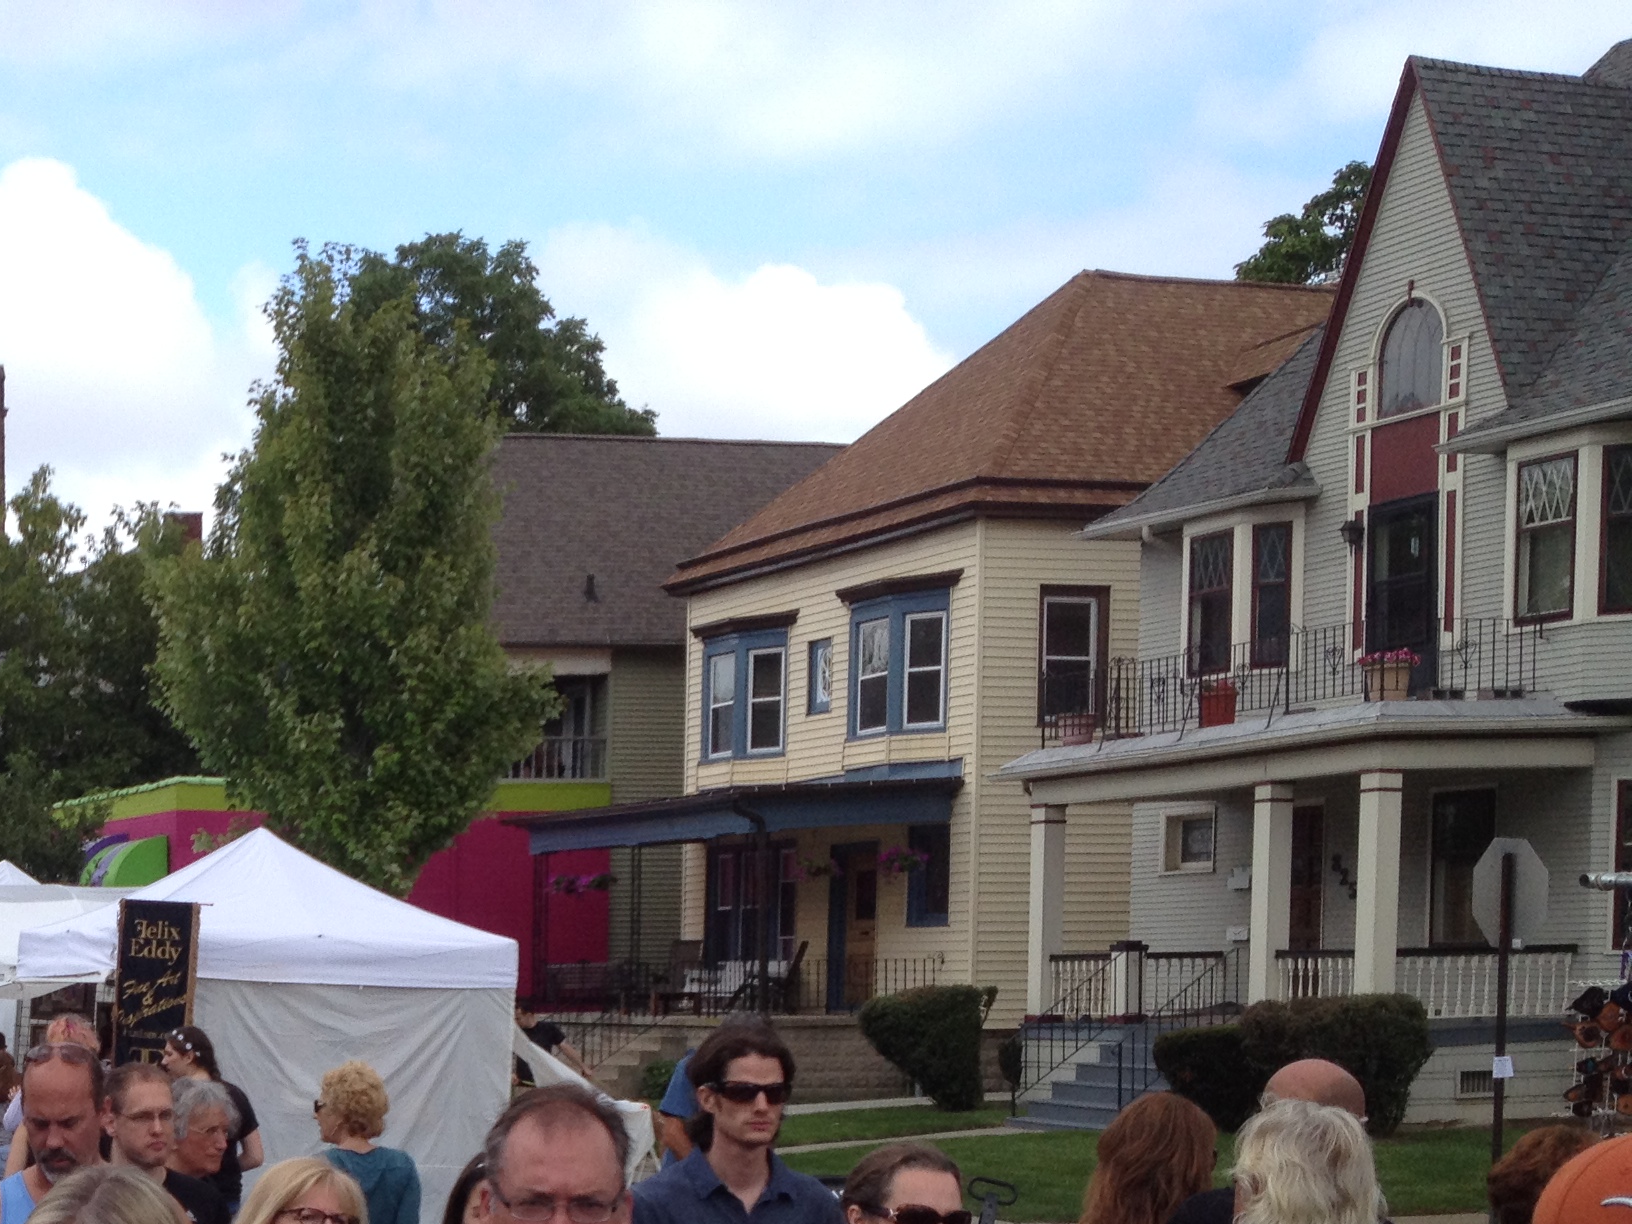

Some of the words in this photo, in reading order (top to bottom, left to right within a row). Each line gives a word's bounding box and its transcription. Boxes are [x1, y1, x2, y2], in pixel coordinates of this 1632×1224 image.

[134, 919, 181, 940] Felix
[128, 938, 183, 966] Eddy
[142, 987, 155, 1006] &
